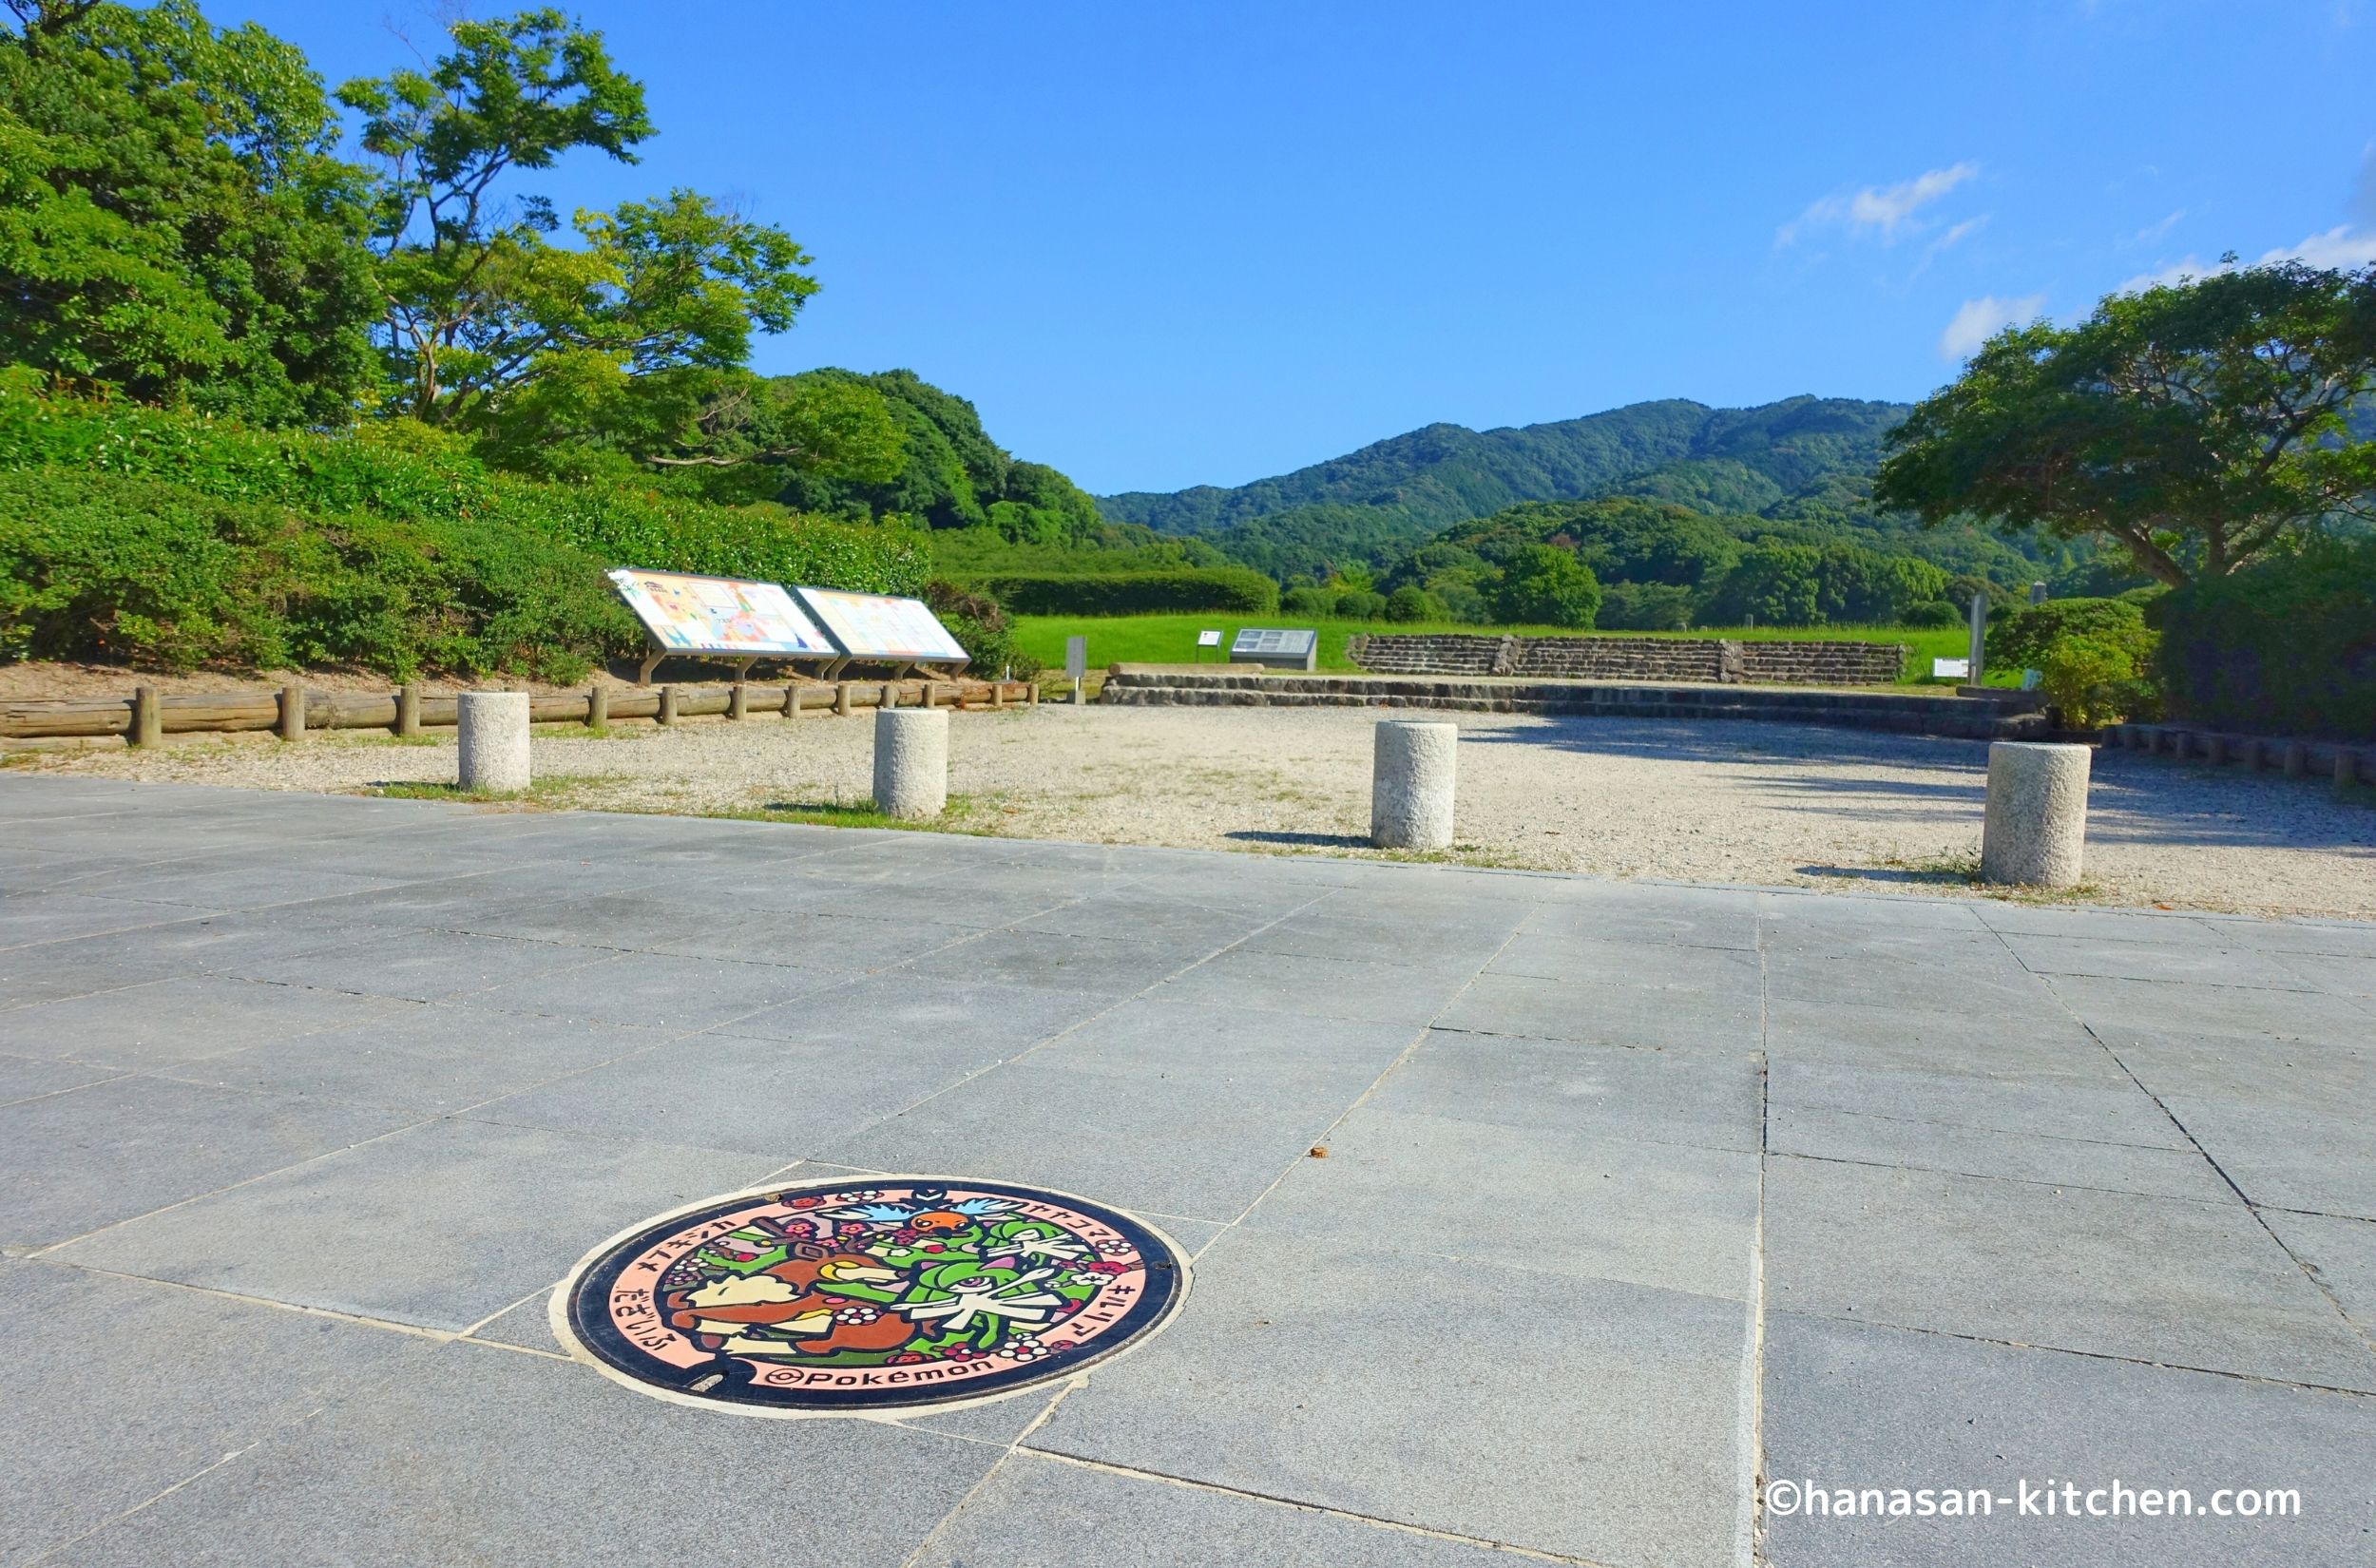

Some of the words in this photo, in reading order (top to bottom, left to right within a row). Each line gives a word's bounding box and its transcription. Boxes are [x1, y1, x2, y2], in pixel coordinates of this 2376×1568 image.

[637, 1220, 737, 1272] メブキジカ
[1028, 1205, 1111, 1236] ヤヤコマ
[614, 1288, 677, 1351] だざいふ
[1070, 1285, 1136, 1337] キルリア
